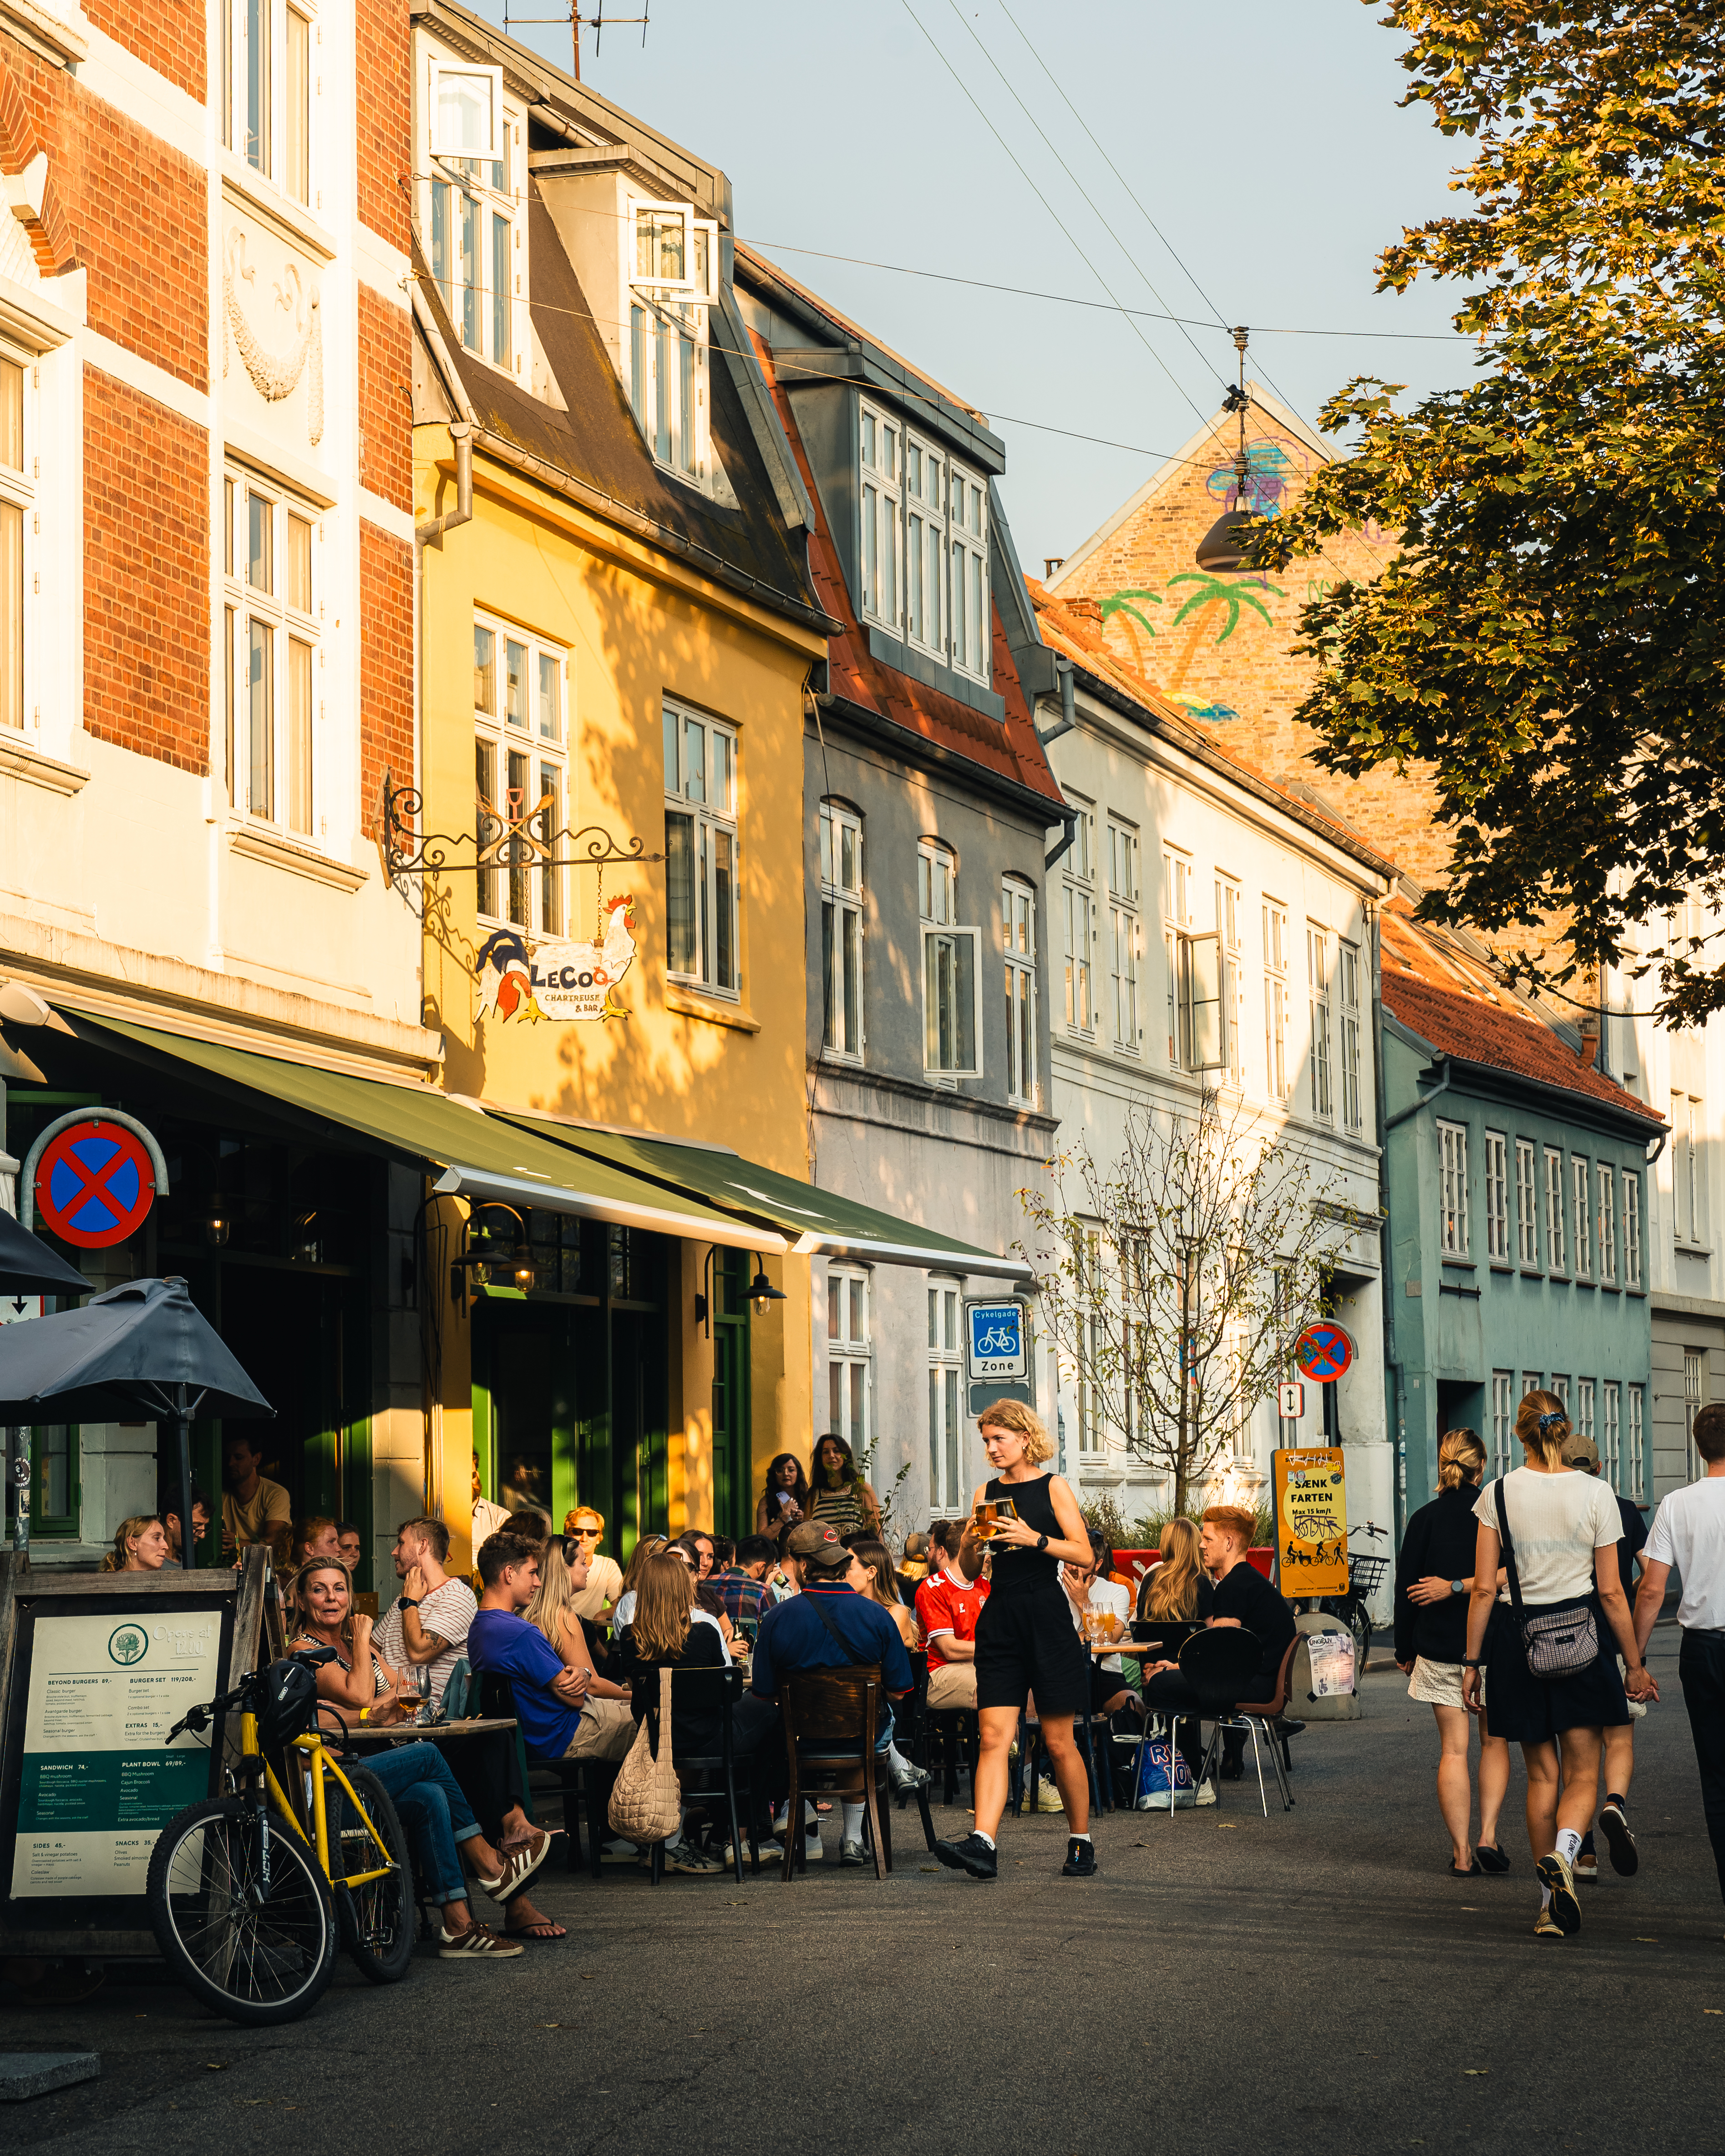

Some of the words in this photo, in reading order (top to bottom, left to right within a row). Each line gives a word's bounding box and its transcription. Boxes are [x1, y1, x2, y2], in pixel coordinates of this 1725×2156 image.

[975, 1311, 1016, 1319] Cykelgade
[981, 1361, 1014, 1372] Zone
[1295, 1479, 1327, 1488] SÆNK
[1291, 1493, 1332, 1503] FARTEN
[153, 1626, 195, 1642] Opens
[199, 1625, 211, 1638] at
[1567, 1837, 1577, 1857] PLANET
